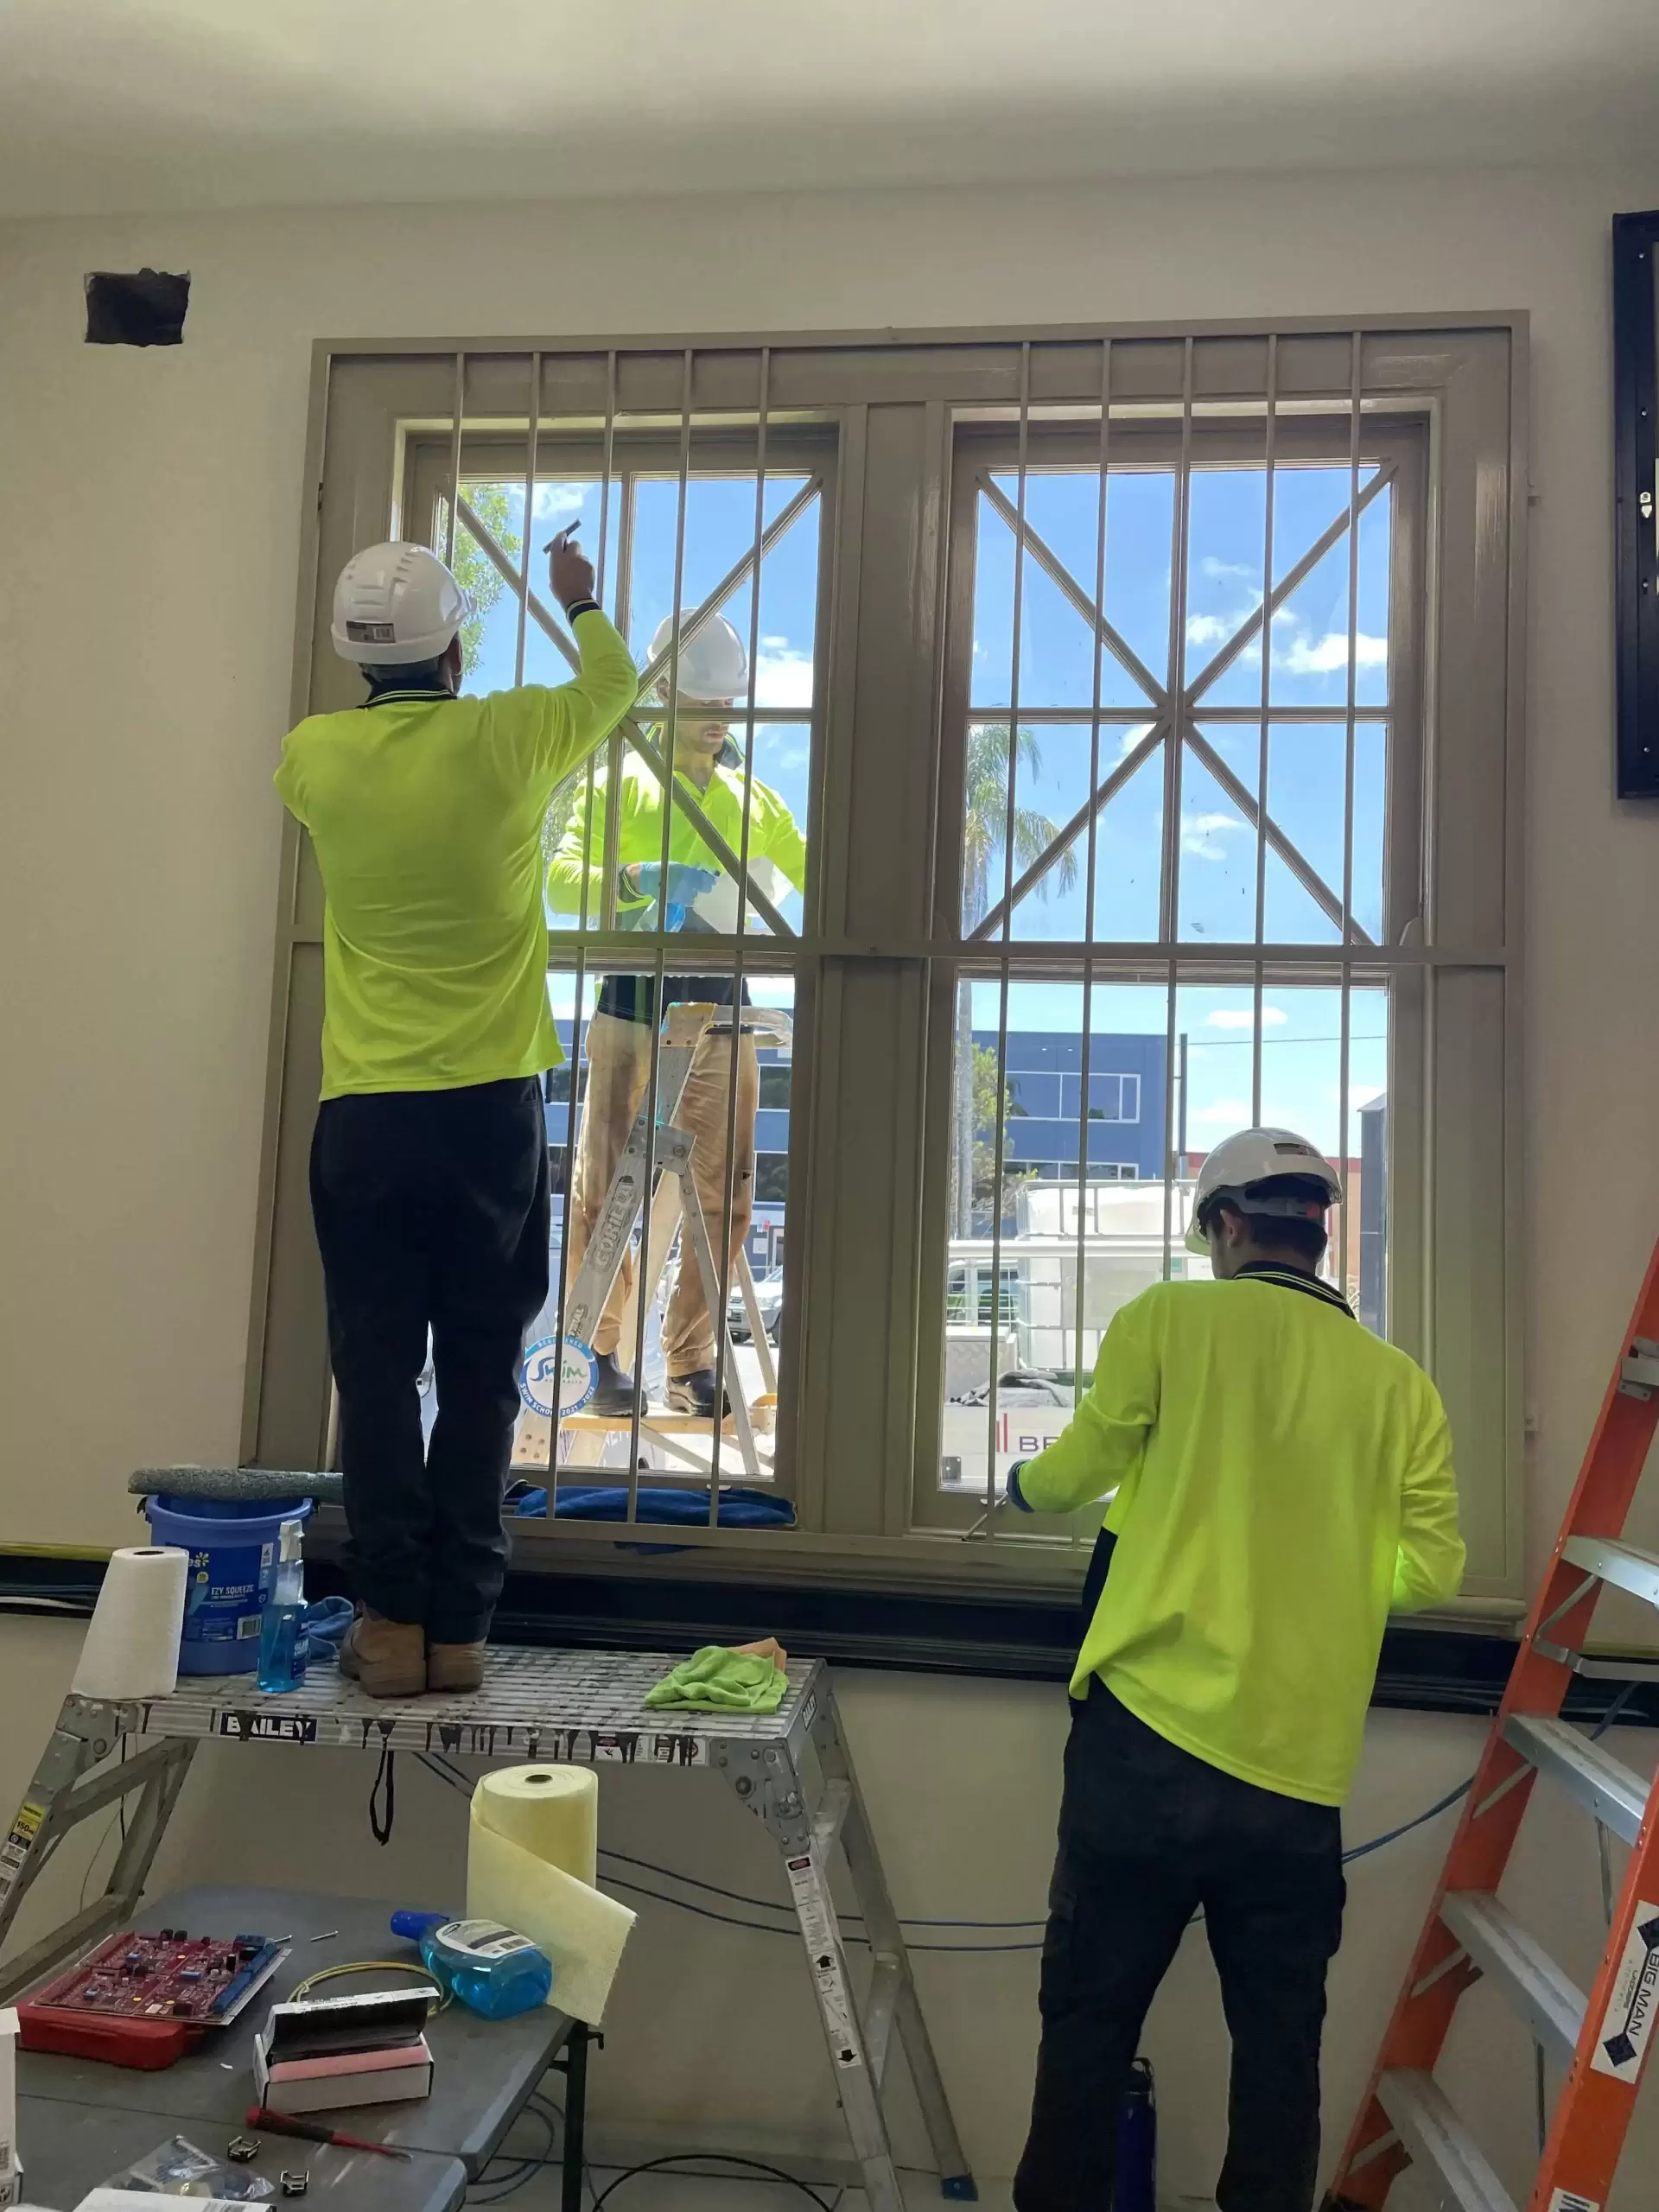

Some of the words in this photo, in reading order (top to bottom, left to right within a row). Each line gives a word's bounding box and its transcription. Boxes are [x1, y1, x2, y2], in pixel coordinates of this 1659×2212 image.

[520, 1382, 533, 1403] SWIM
[226, 1584, 254, 1596] SQUEEZE
[1628, 1988, 1651, 2037] MAN
